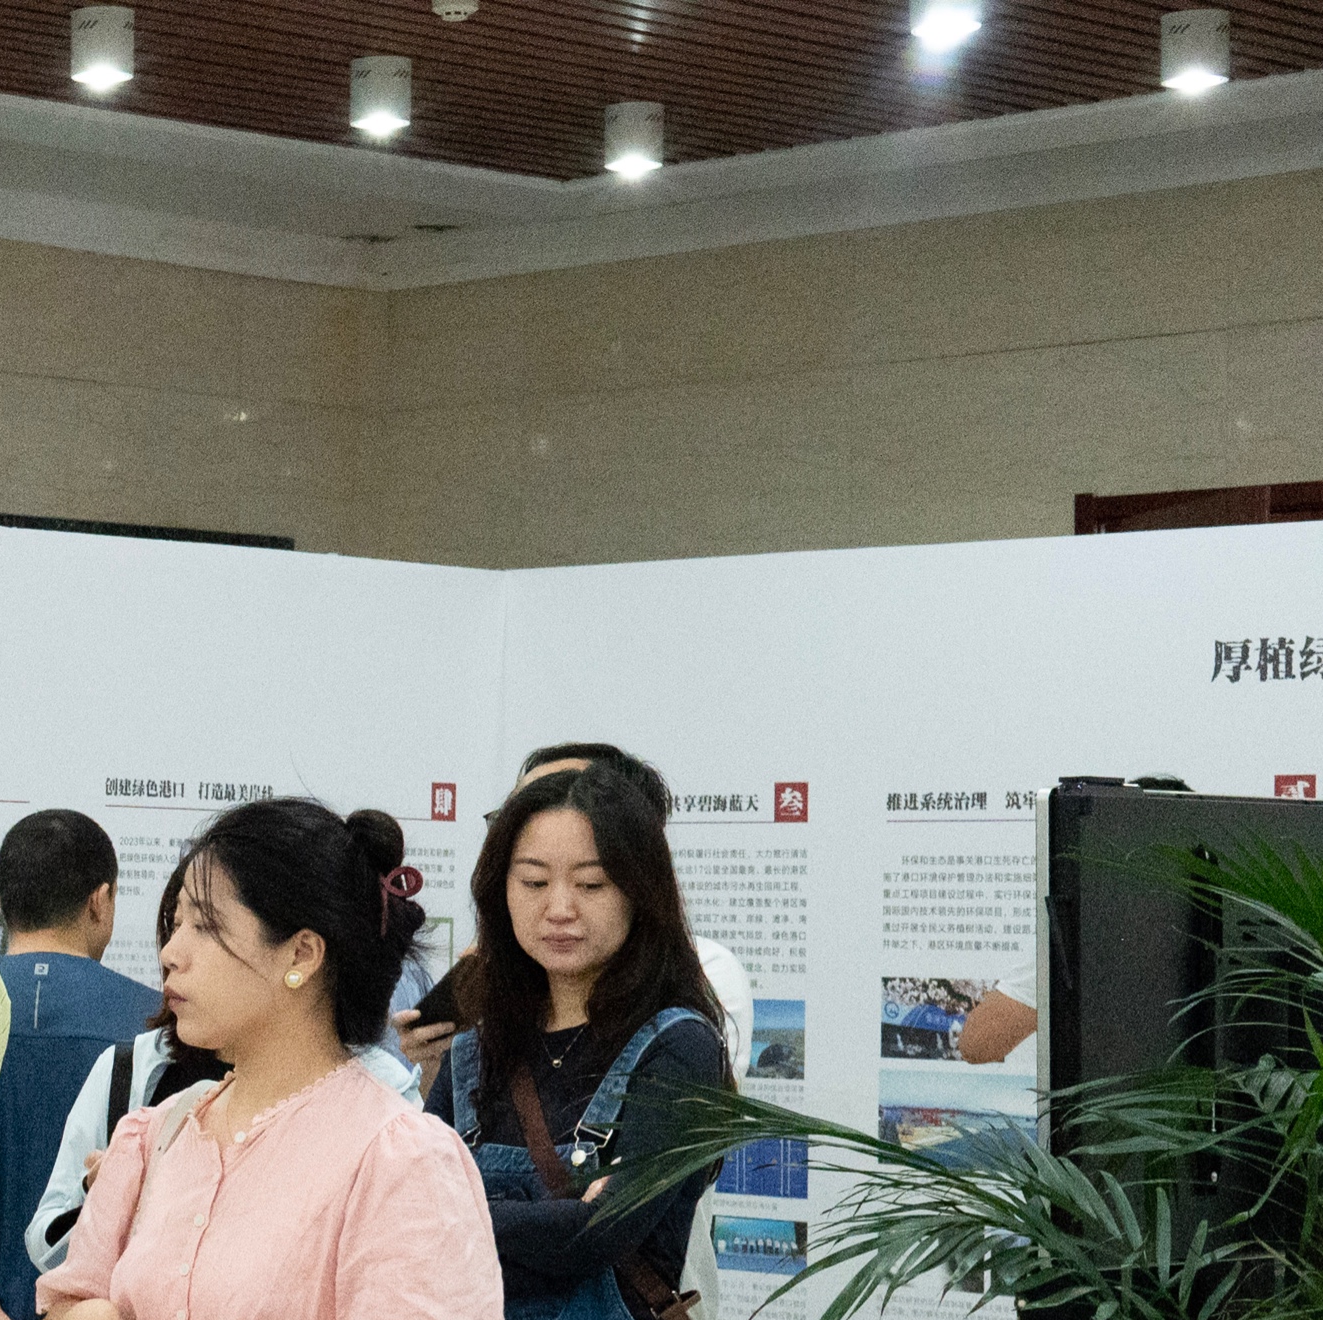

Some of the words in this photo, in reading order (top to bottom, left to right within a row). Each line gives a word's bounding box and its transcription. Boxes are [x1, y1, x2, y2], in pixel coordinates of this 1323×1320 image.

[105, 777, 185, 799] 创建绿色港口
[779, 787, 803, 816] 叁
[886, 790, 987, 812] 推进系统治理
